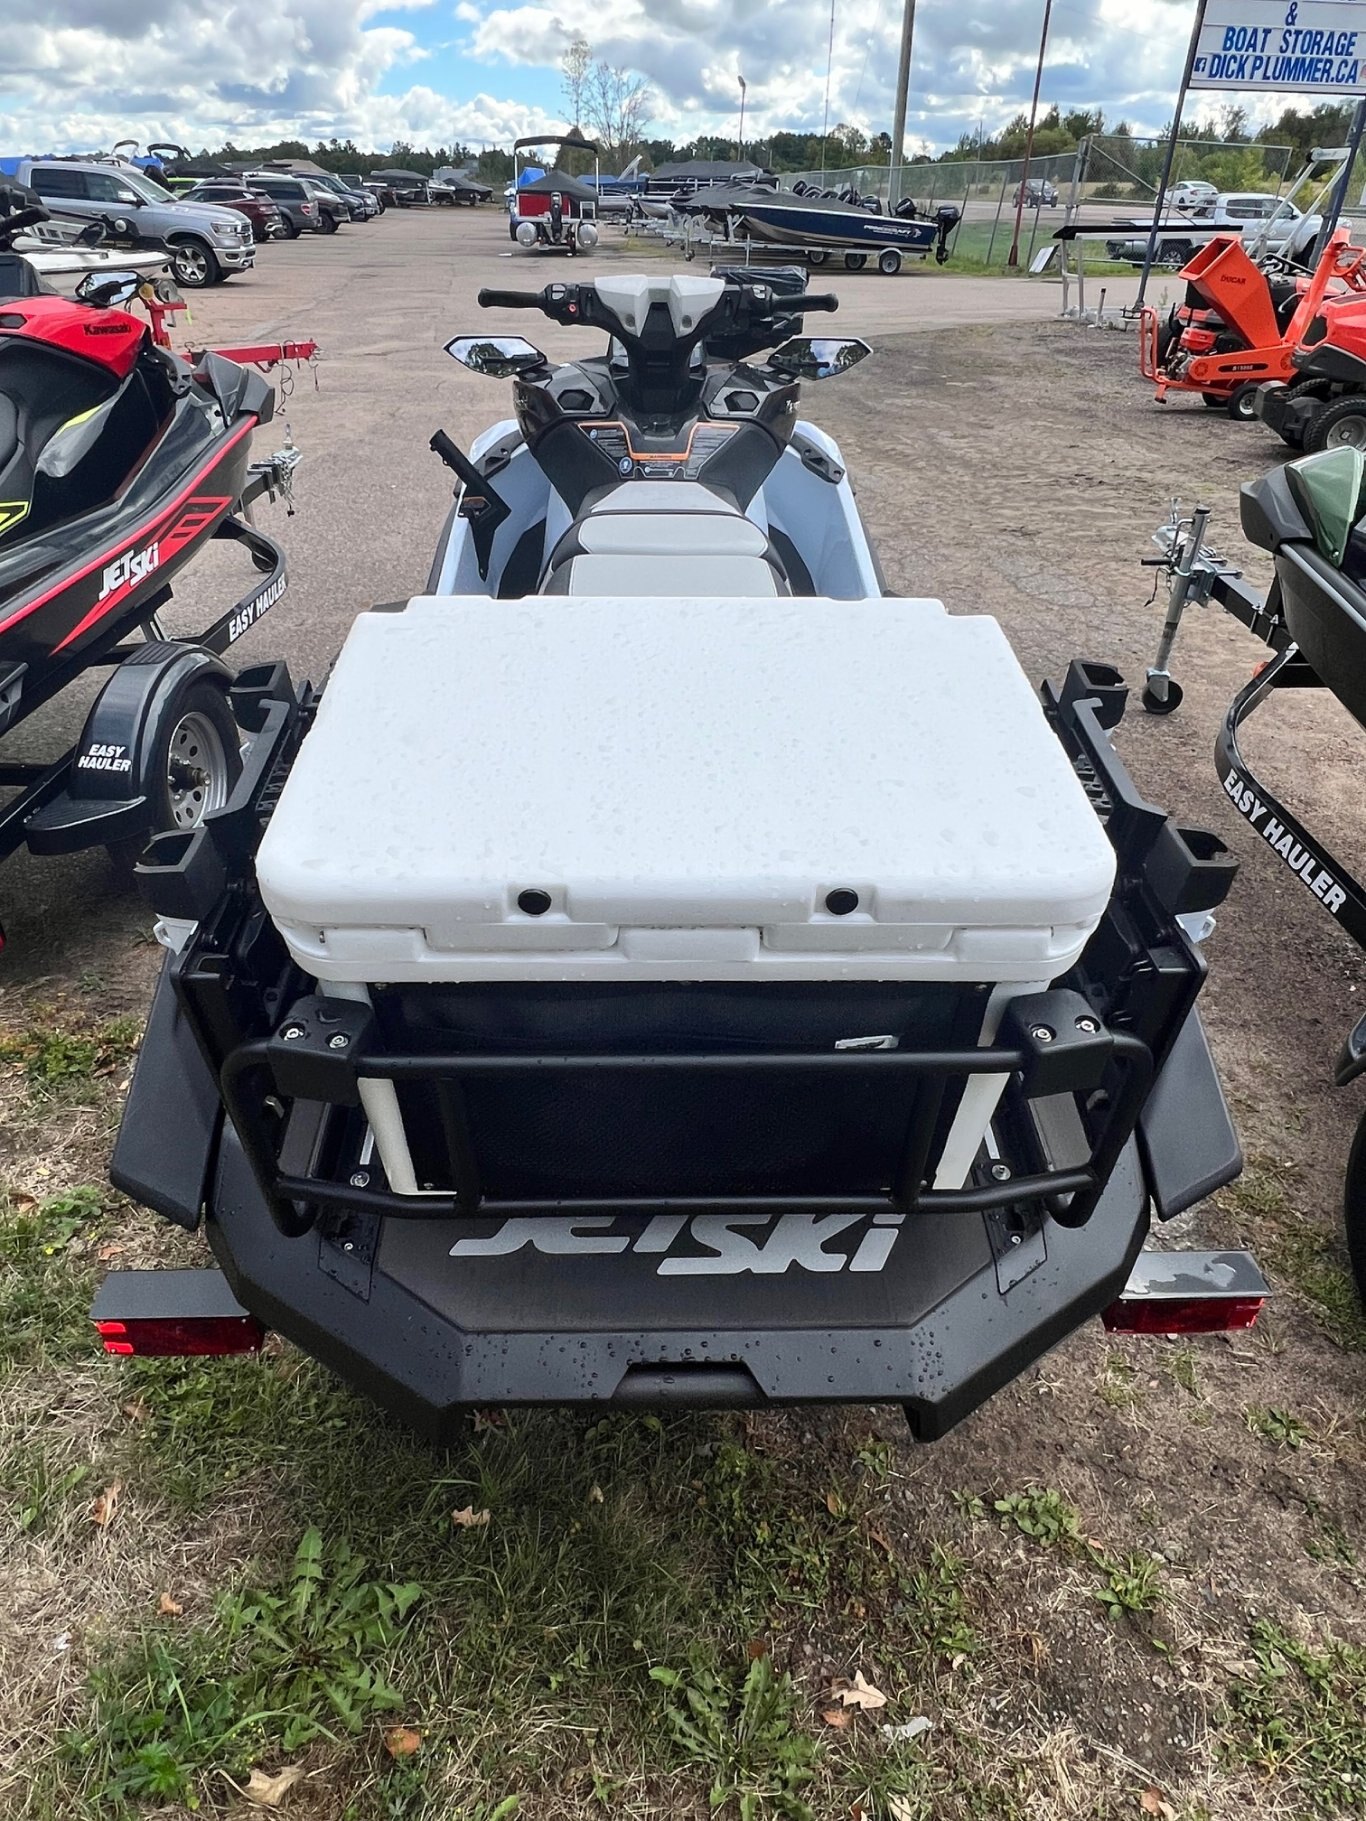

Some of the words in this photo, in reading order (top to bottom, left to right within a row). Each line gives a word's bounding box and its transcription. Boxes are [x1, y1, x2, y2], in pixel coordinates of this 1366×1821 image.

[1285, 1, 1298, 26] &
[1222, 26, 1272, 53] BOAT
[1279, 28, 1358, 57] STORAGE
[83, 323, 132, 336] Kawasaki
[228, 602, 254, 643] EASY
[255, 572, 287, 618] HAULER
[78, 755, 132, 772] HAULER
[88, 744, 126, 758] EASY
[1223, 768, 1268, 823] EASY
[1262, 817, 1347, 914] HAULER
